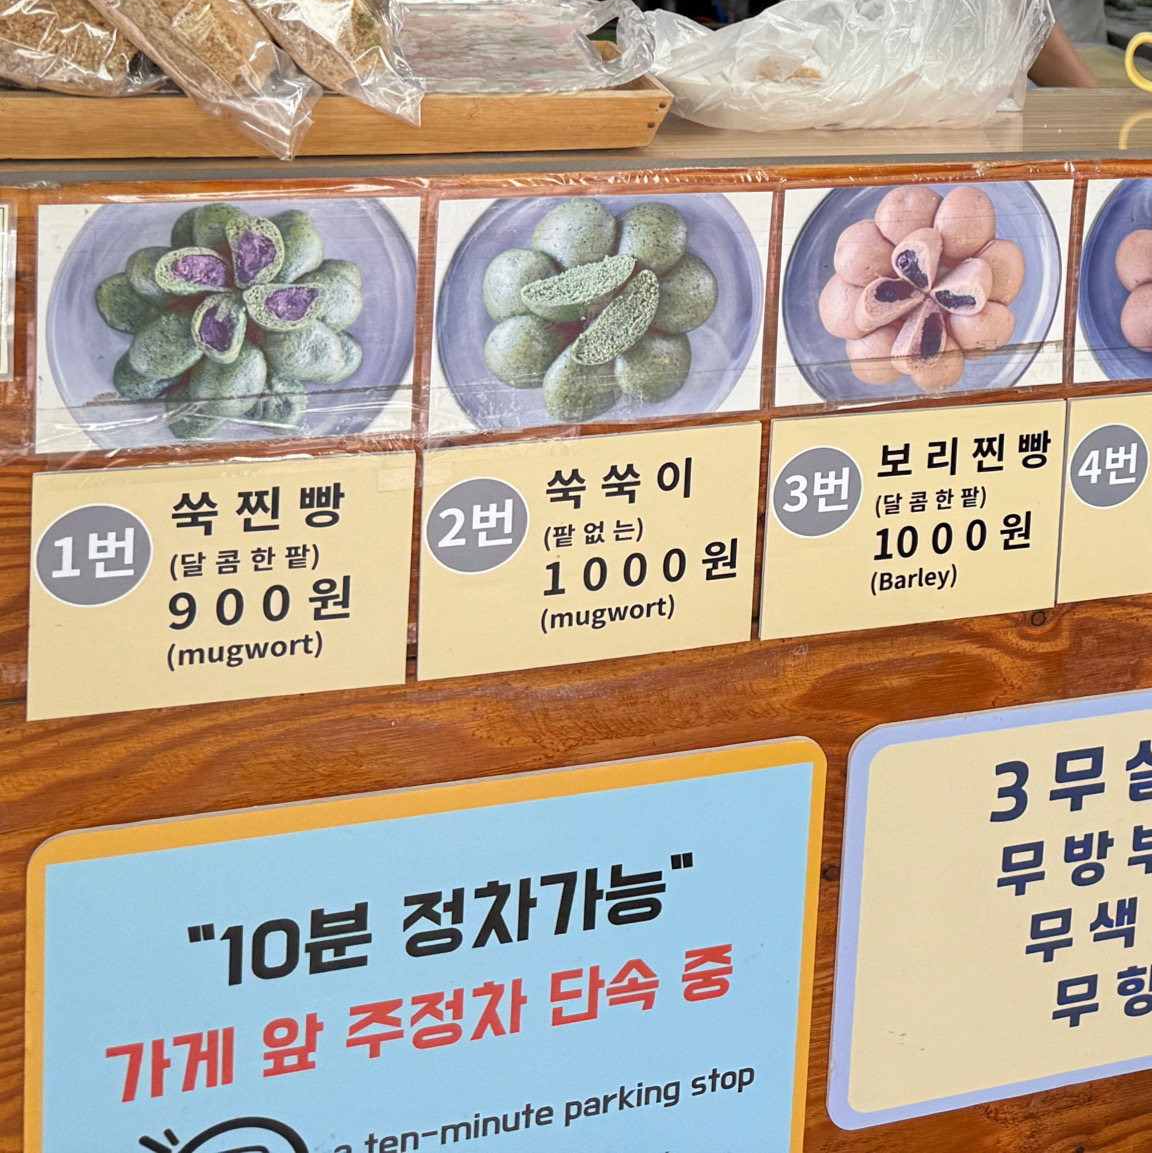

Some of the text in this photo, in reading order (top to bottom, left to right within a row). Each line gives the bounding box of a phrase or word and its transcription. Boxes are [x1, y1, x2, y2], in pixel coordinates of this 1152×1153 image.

[1078, 443, 1137, 485] 4번
[783, 467, 849, 512] 3번
[438, 499, 513, 547] 2번
[52, 528, 134, 578] 1번
[871, 564, 956, 596] (Barley)
[541, 594, 674, 634] (mugwort)
[168, 631, 322, 671] (mugwort)
[188, 852, 694, 986] "10분 정차가능"
[106, 945, 732, 1102] 가게 앞 주정차 단속 중
[365, 1068, 754, 1153] ten-minute parking stop
